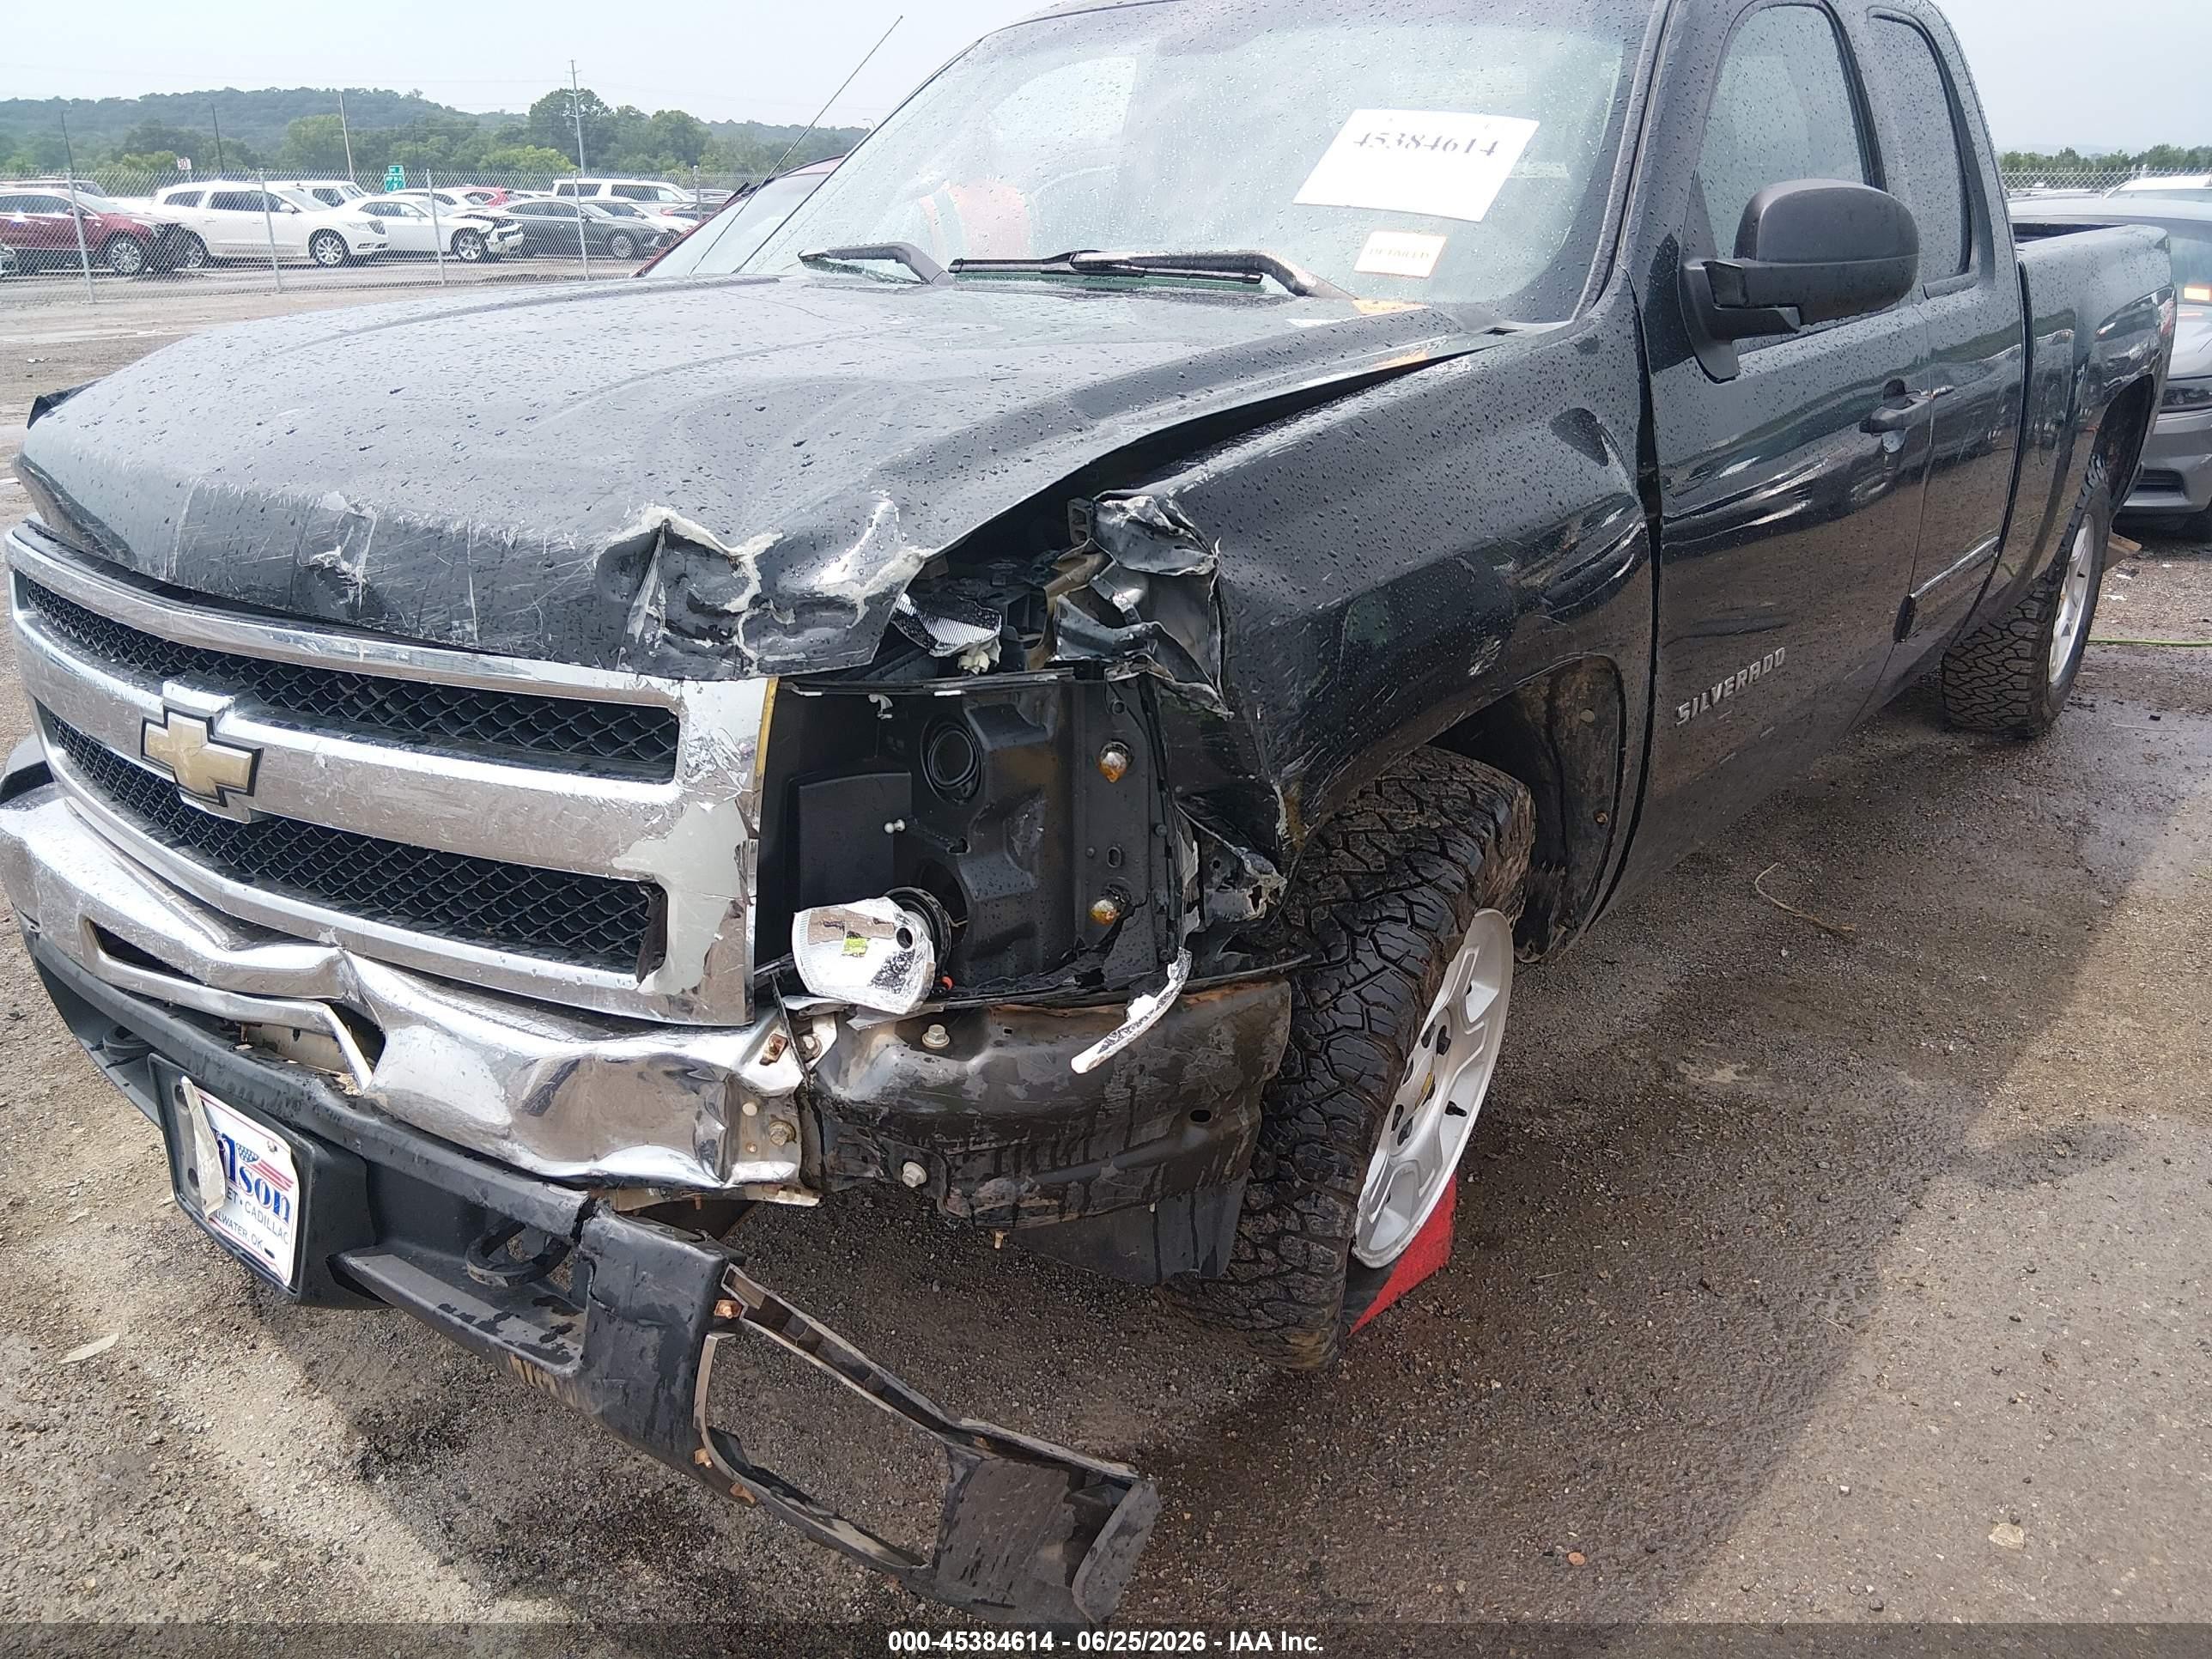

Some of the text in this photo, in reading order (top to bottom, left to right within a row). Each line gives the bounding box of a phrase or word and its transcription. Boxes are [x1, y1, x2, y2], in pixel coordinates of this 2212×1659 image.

[1352, 131, 1498, 156] 45384614
[1675, 647, 1785, 727] SILVERADO
[245, 1200, 289, 1245] CADILLAC
[251, 1234, 264, 1252] OK
